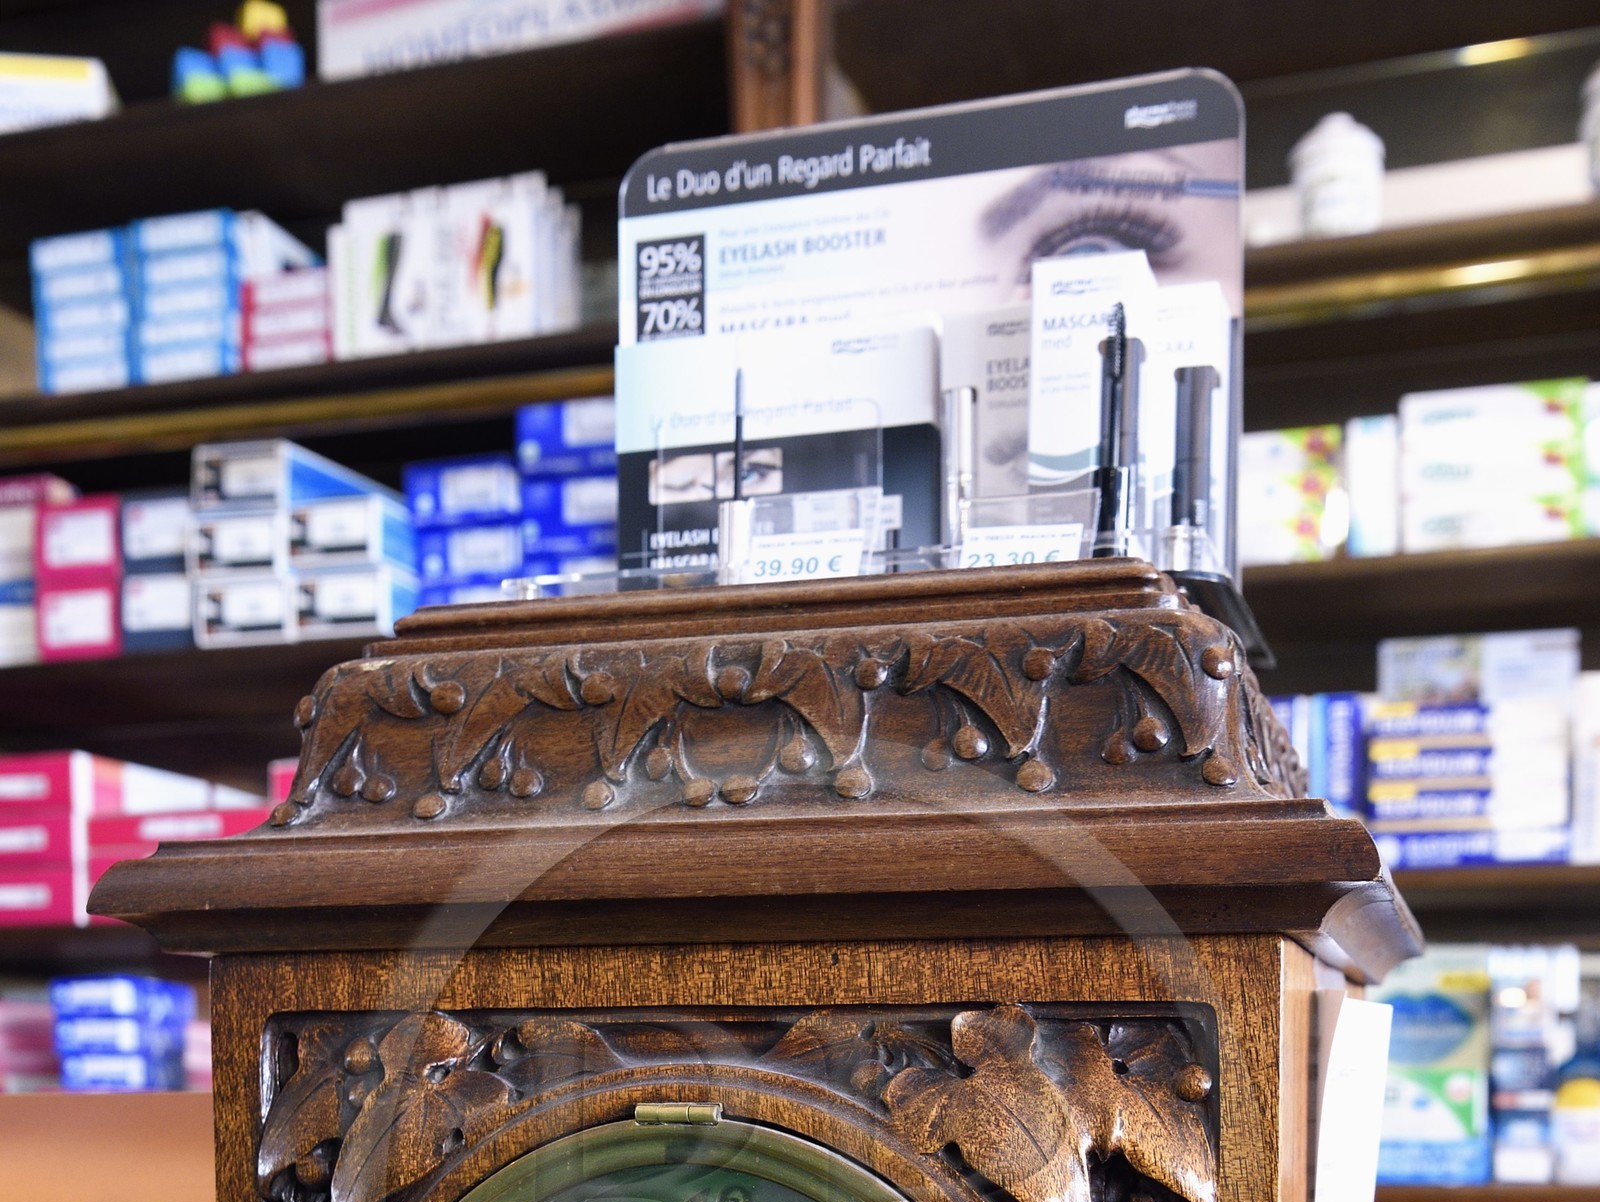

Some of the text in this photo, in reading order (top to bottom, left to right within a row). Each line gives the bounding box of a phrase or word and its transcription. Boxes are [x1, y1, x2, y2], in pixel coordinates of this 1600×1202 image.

[647, 137, 931, 202] Le Duo d'un Regard Parfait
[639, 240, 702, 279] 95%
[720, 228, 887, 265] EYELASH BOOSTER
[640, 296, 702, 335] 70%
[1043, 310, 1116, 332] MASCAR
[987, 357, 1030, 375] EYELA
[754, 554, 843, 577] 39.90 €
